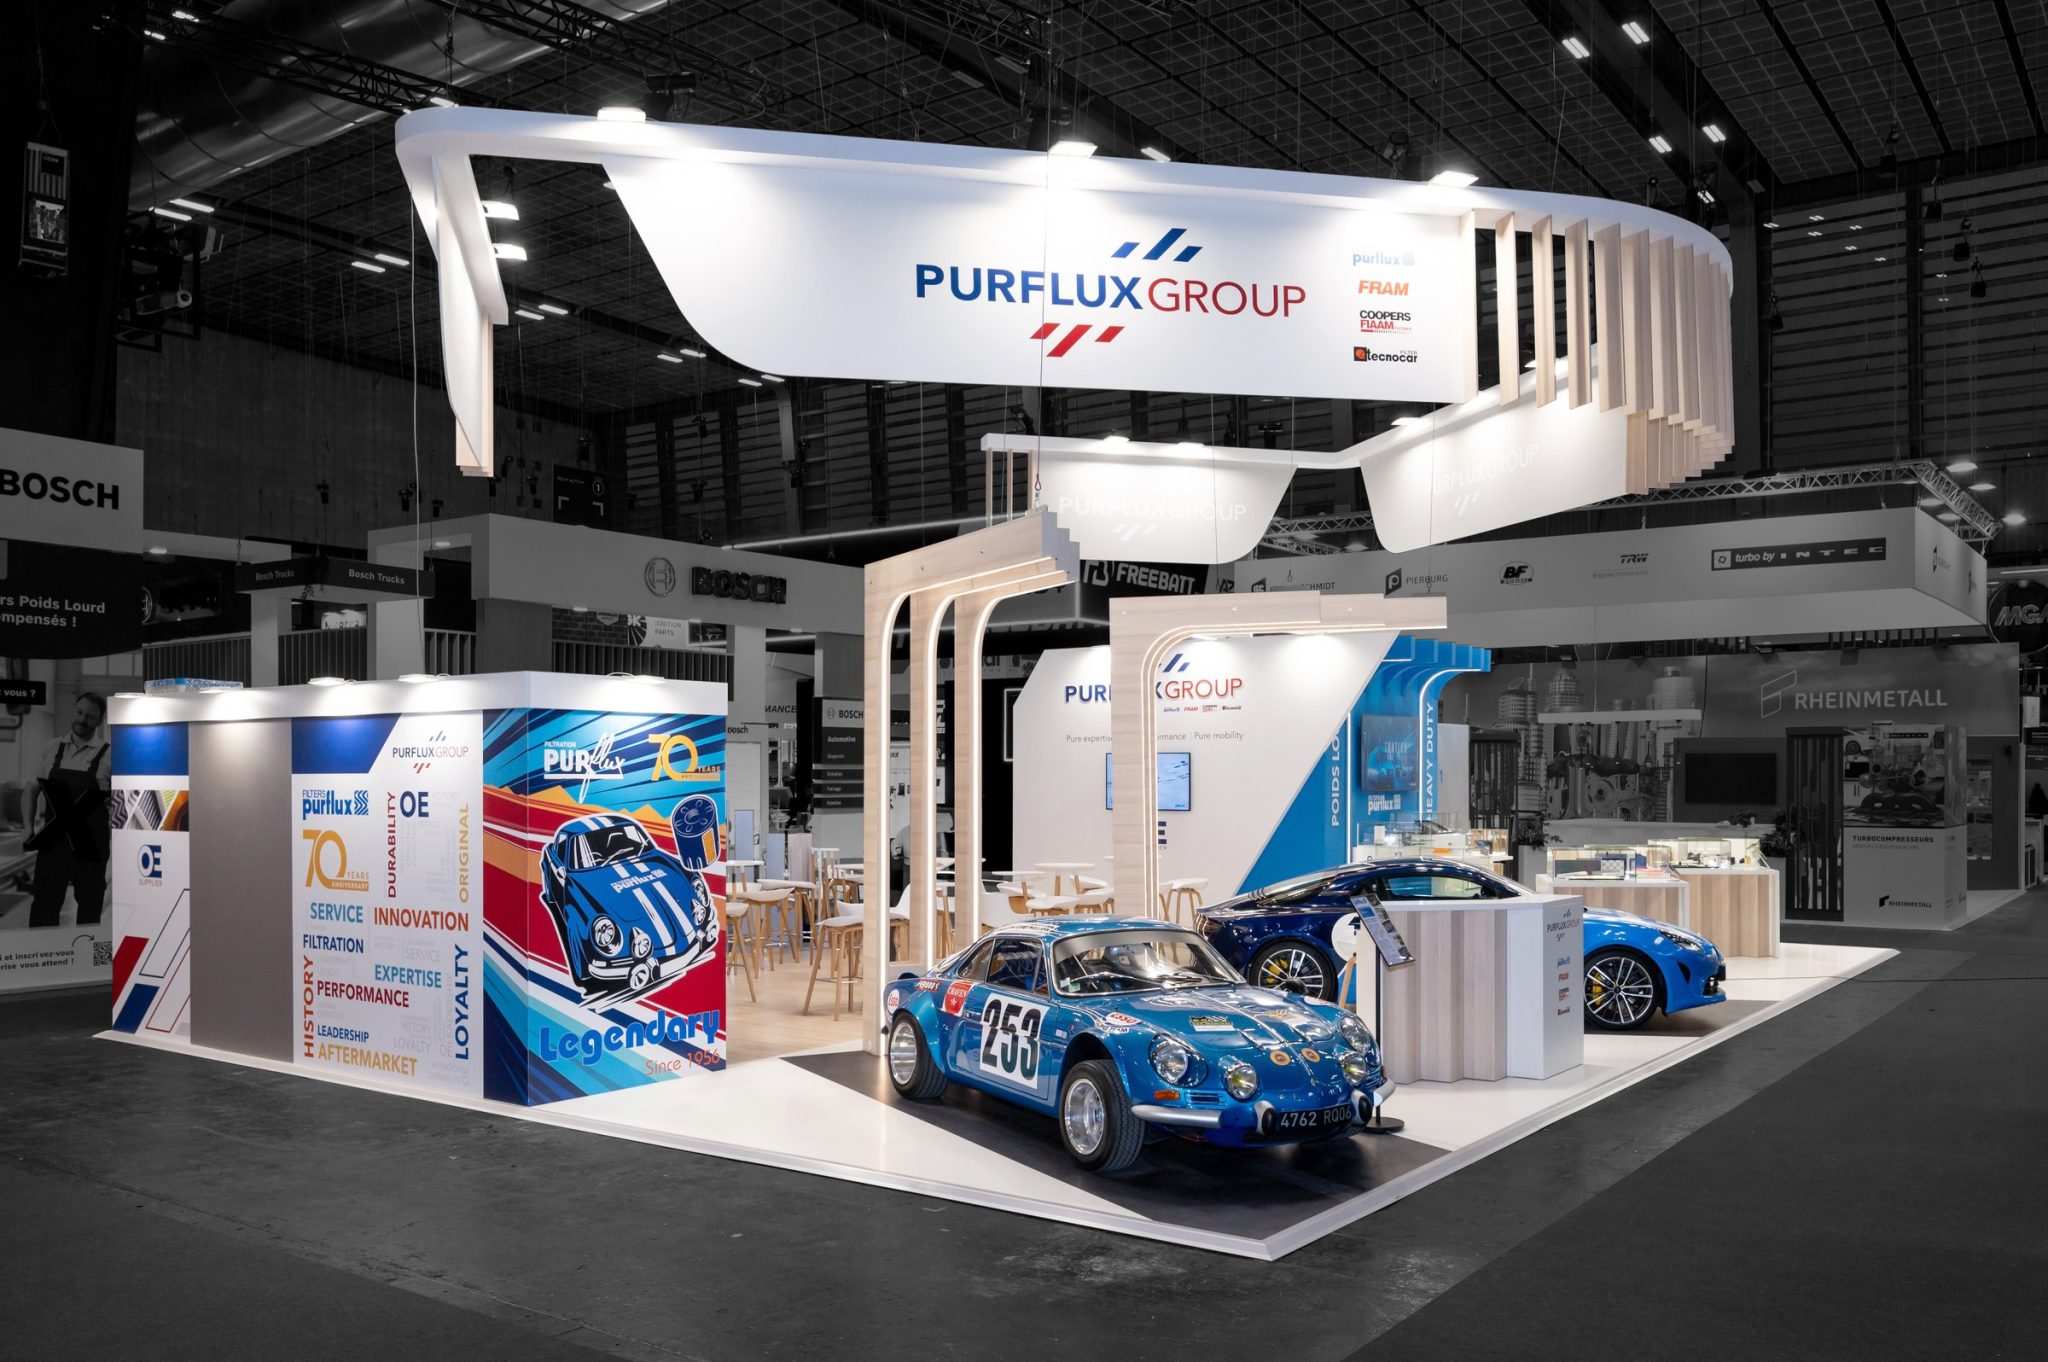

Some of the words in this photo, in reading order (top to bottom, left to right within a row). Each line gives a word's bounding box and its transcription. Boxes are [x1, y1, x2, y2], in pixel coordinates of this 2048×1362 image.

[1358, 280, 1409, 296] FRAM
[1359, 310, 1411, 321] COOPERS
[1360, 319, 1394, 330] FIAAM
[1367, 350, 1418, 363] tecnocar
[0, 468, 119, 510] BOSCH
[1620, 553, 1648, 564] TRW
[1735, 553, 1760, 562] turbo
[1763, 552, 1774, 562] by
[256, 572, 273, 581] Bosch
[275, 570, 294, 578] Trucks
[349, 569, 375, 580] Bosch
[378, 573, 405, 584] Trucks
[1116, 563, 1195, 594] FREEBATT
[1406, 574, 1448, 585] PIERBURG
[1503, 565, 1528, 579] BF
[691, 566, 787, 604] BOSCH
[19, 595, 60, 610] Poids
[65, 600, 105, 613] Lourd
[0, 612, 67, 626] mpensés
[72, 616, 77, 627] !
[654, 628, 674, 637] PARTS
[30, 689, 36, 698] ?
[1795, 689, 1947, 710] RHEINMETALL
[838, 710, 864, 719] BOSCH
[1194, 732, 1212, 740] Pure
[1214, 731, 1244, 742] mobility
[1426, 702, 1434, 753] DUTY
[827, 735, 855, 743] Automotive
[648, 734, 698, 781] 70
[302, 790, 326, 798] FILTERS
[1331, 766, 1340, 826] POIDS
[1426, 760, 1434, 821] HEAVY
[303, 790, 352, 820] purflux
[400, 790, 429, 818] OE
[1368, 796, 1393, 815] purflux
[387, 792, 397, 898] DURABILITY
[1853, 835, 1934, 843] TURBOCOMPRESSEURS
[137, 844, 162, 878] OE
[303, 829, 347, 889] 70
[459, 803, 469, 903] ORIGINAL
[138, 879, 162, 887] SUPPLIER
[346, 872, 369, 880] YEARS
[331, 881, 369, 890] ANNIVERSARY
[310, 902, 363, 923] SERVICE
[1888, 900, 1933, 909] RHEINMETALL
[374, 907, 469, 931] INNOVATION
[303, 934, 364, 953] FILTRATION
[41, 959, 68, 967] attend
[405, 948, 441, 963] SERVICE
[375, 964, 442, 988] EXPERTISE
[317, 981, 409, 1008] PERFORMANCE
[455, 944, 469, 1060] LOYALTY
[303, 955, 314, 1058] HISTORY
[317, 1025, 369, 1043] LEADERSHIP
[540, 1010, 720, 1066] Legendary
[982, 998, 1042, 1081] 253
[394, 1037, 432, 1053] LOYALTY
[318, 1043, 418, 1076] AFTERMARKET
[645, 1058, 681, 1076] Since
[688, 1049, 720, 1068] 1956
[1280, 1112, 1317, 1127] 4762
